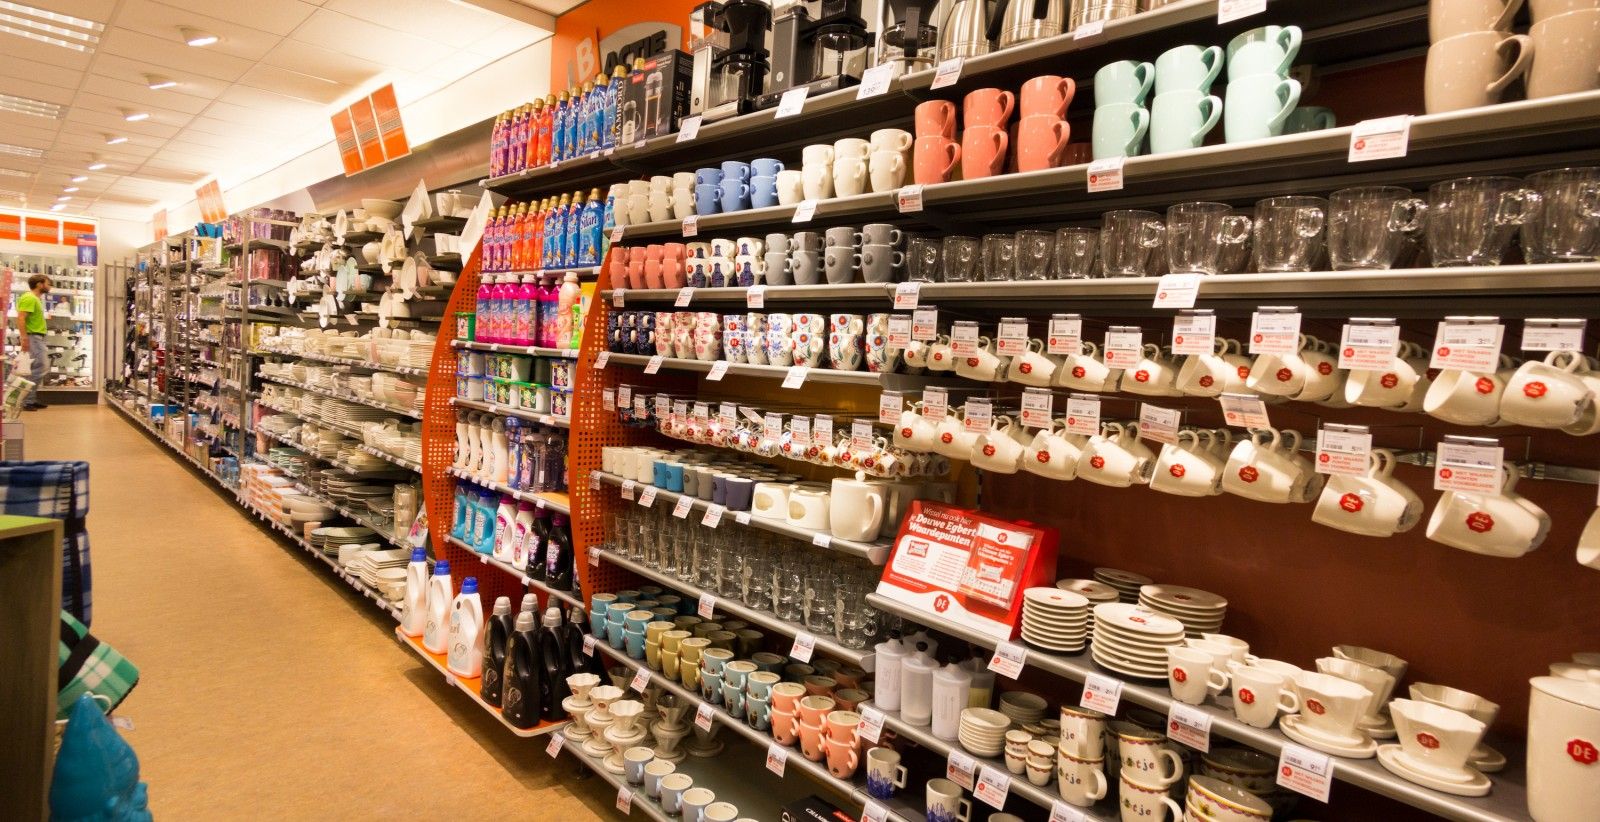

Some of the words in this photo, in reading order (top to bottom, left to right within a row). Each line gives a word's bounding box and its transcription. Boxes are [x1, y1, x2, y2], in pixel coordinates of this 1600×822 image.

[604, 29, 667, 78] ACTIE
[580, 214, 597, 229] Silan
[916, 513, 946, 529] Douwe
[945, 521, 977, 536] Egbert
[923, 508, 942, 518] Wissel
[908, 521, 971, 547] Waardepunten
